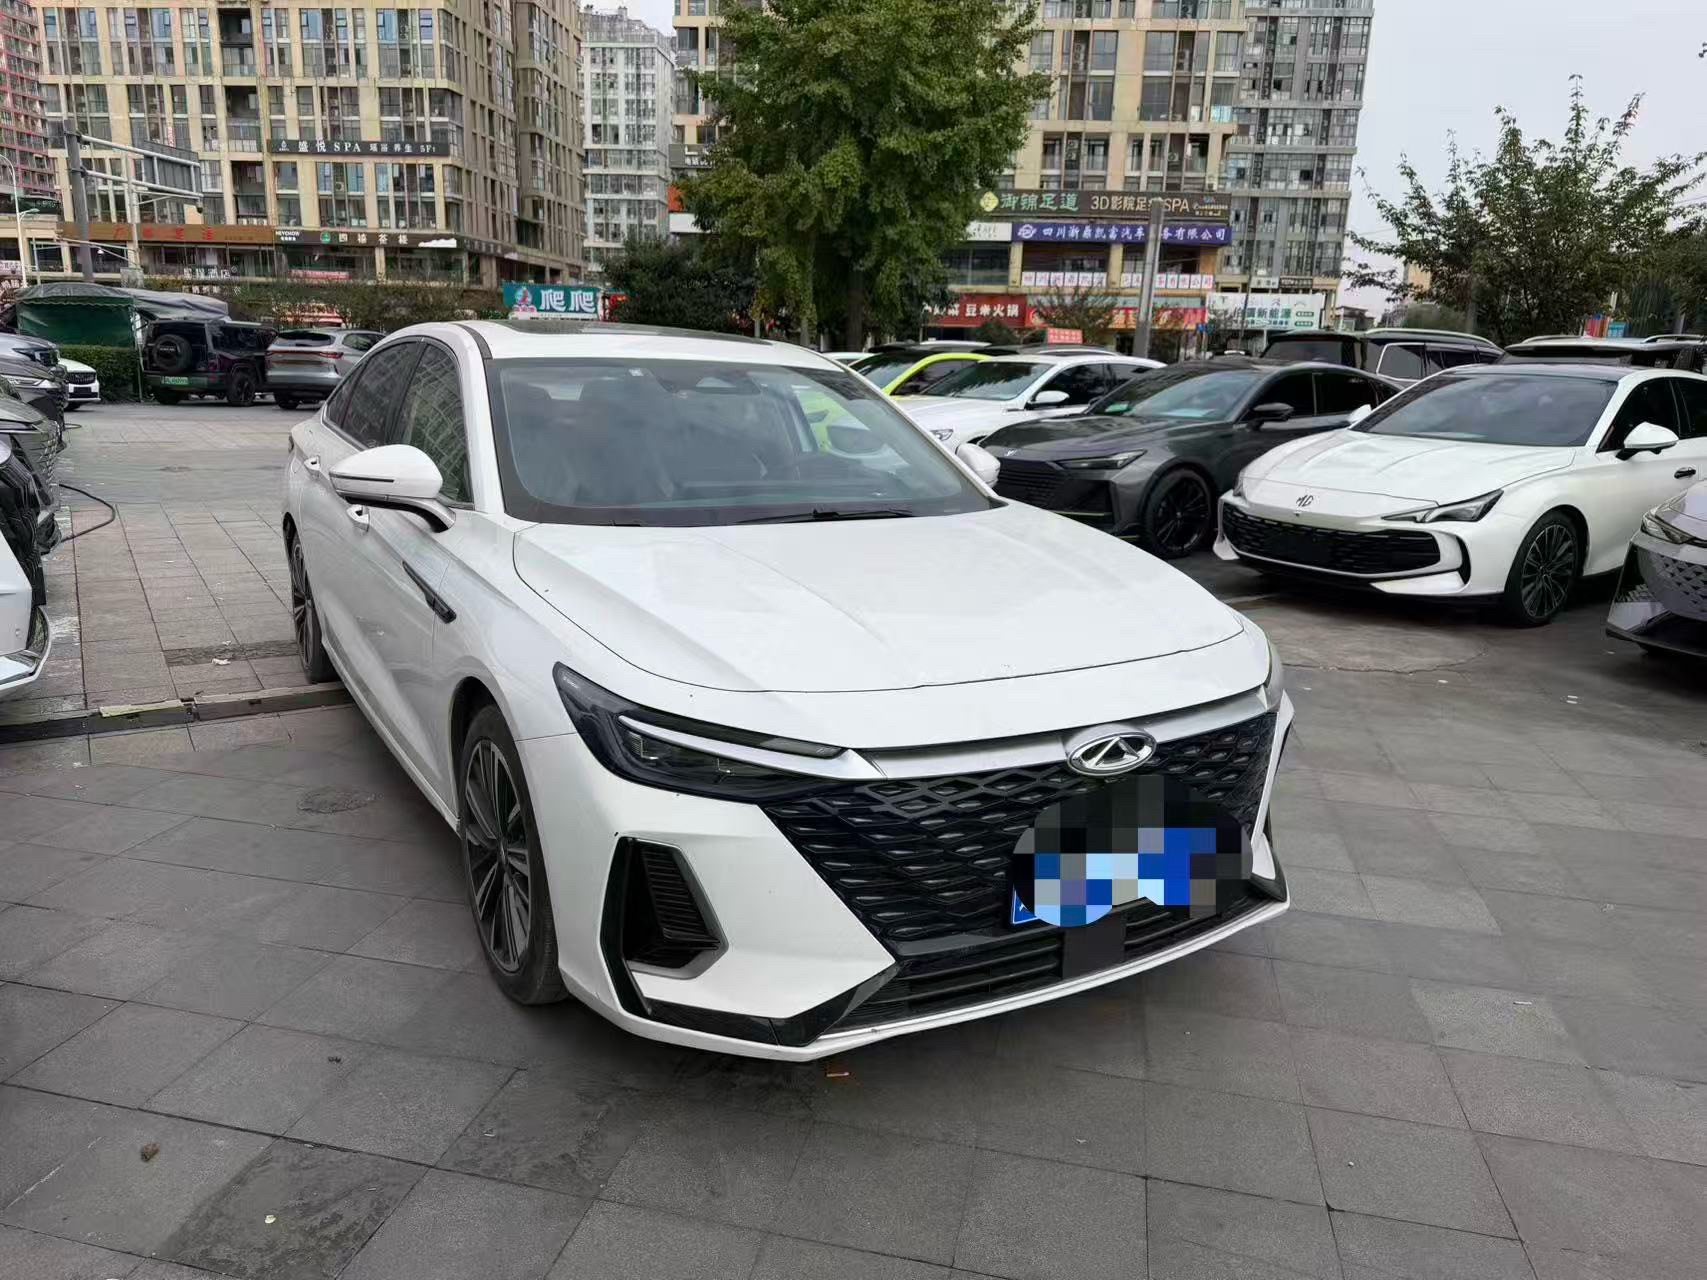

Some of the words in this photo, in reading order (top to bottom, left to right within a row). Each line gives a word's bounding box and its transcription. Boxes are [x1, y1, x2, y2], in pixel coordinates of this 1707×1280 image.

[333, 142, 361, 153] SPA
[540, 289, 595, 313] 爬爬
[1296, 494, 1314, 507] MG
